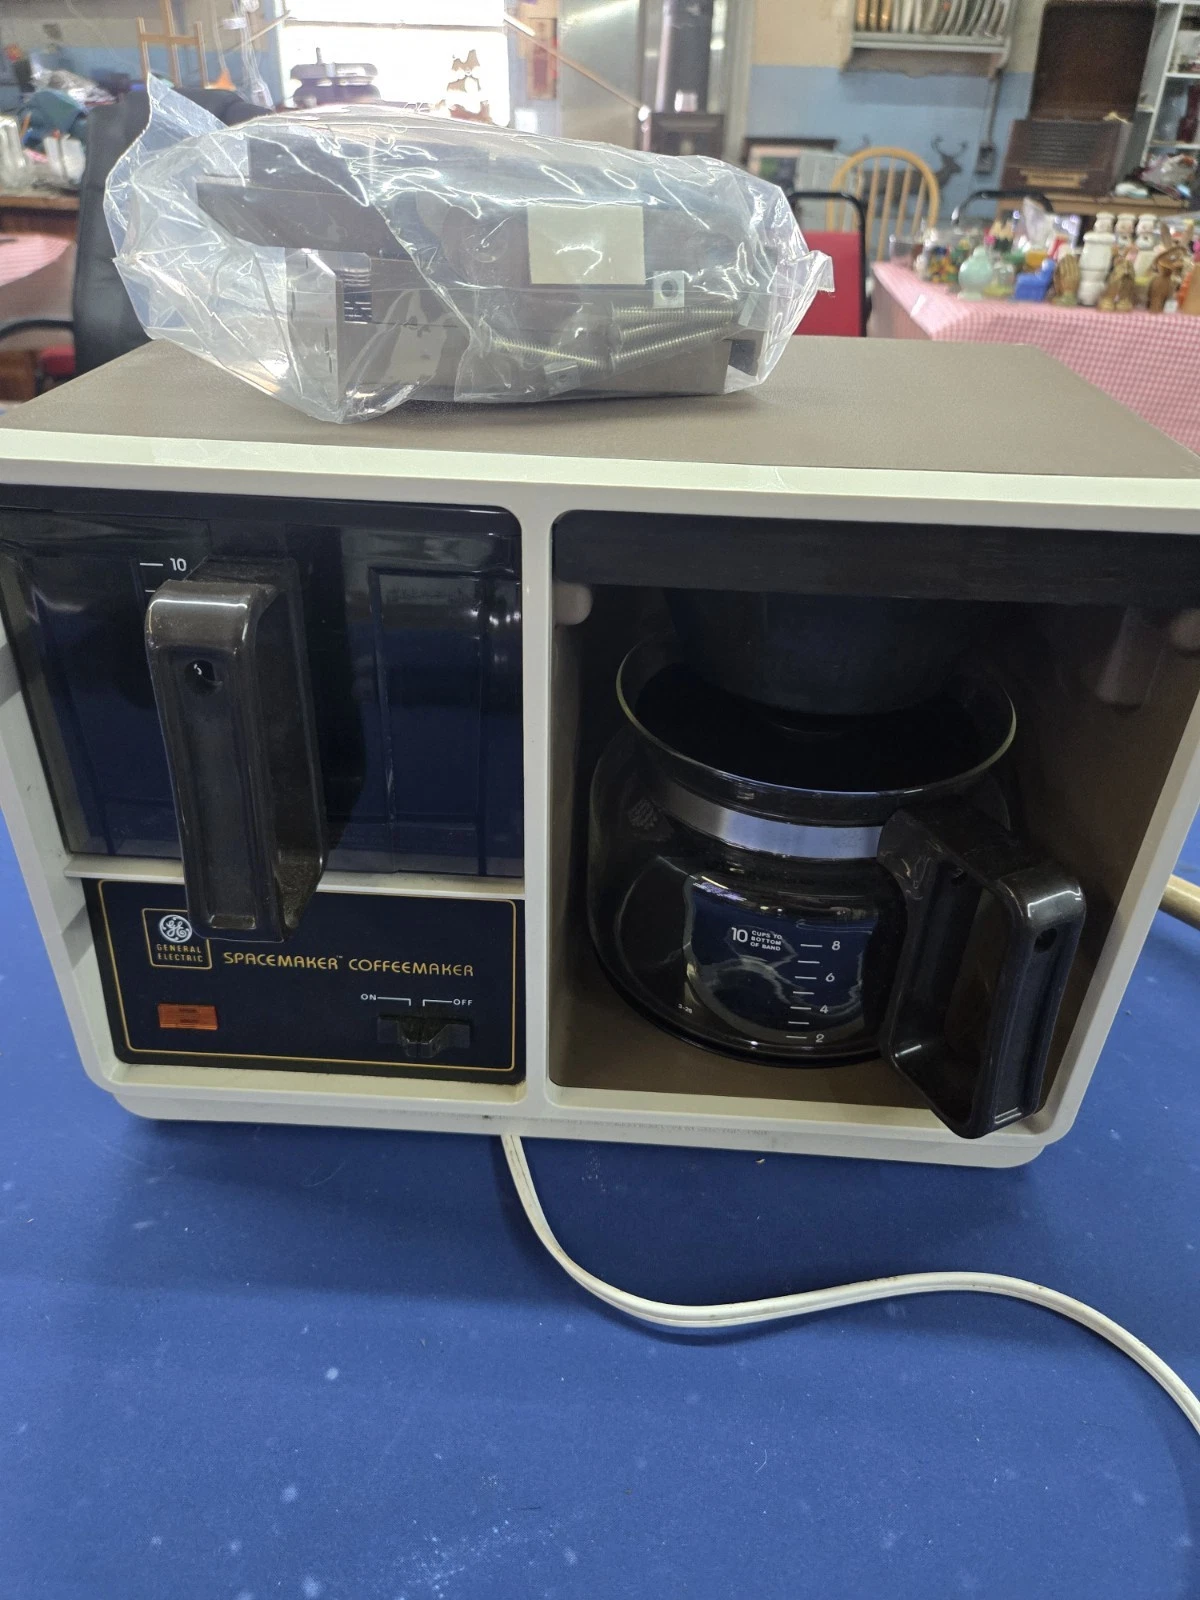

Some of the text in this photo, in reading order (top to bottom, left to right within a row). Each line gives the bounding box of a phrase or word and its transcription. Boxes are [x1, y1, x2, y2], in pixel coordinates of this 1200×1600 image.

[169, 557, 187, 572] 10
[731, 926, 749, 943] 10
[751, 930, 771, 939] CUPS
[751, 935, 782, 946] BOTTOM
[831, 940, 841, 951] 8
[156, 943, 202, 954] GENERAL
[761, 943, 781, 952] BAND
[157, 953, 204, 963] ELECTRIC
[348, 958, 474, 977] COFFEEMAKER
[825, 972, 835, 983] 6
[360, 993, 377, 1002] ON
[453, 998, 473, 1006] OFF
[819, 1004, 829, 1014] 4
[815, 1033, 825, 1043] 2
